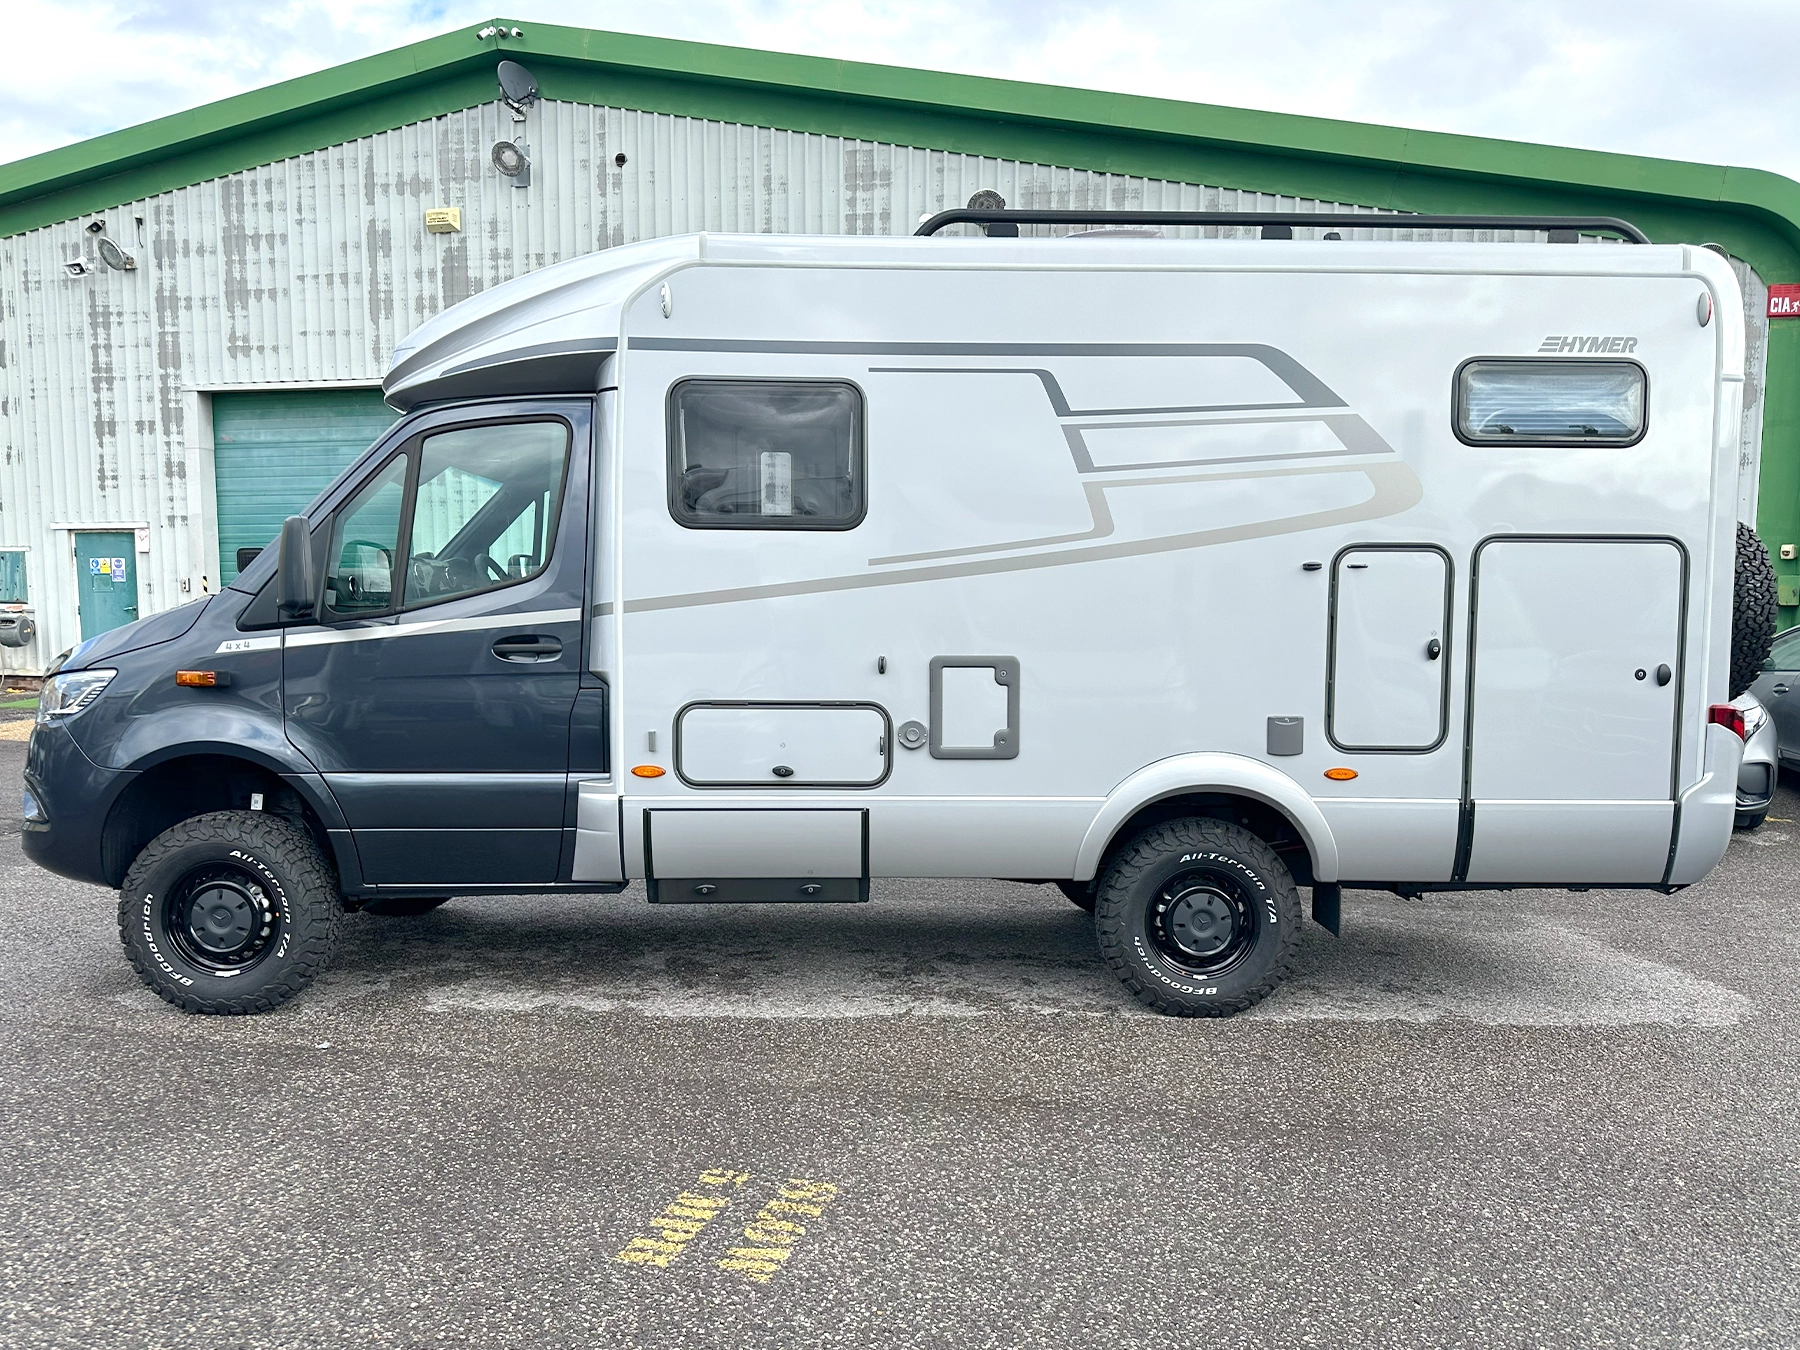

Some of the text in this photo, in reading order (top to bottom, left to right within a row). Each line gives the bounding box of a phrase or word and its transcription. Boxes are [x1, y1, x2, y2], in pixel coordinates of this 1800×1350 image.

[1770, 297, 1790, 313] CIA
[1558, 336, 1638, 353] HYMER
[229, 850, 292, 958] All-Terrain T/A
[1179, 853, 1277, 924] All-Terrain T/A
[141, 893, 194, 987] BFGoodrich
[1134, 937, 1218, 995] BFGoodrich
